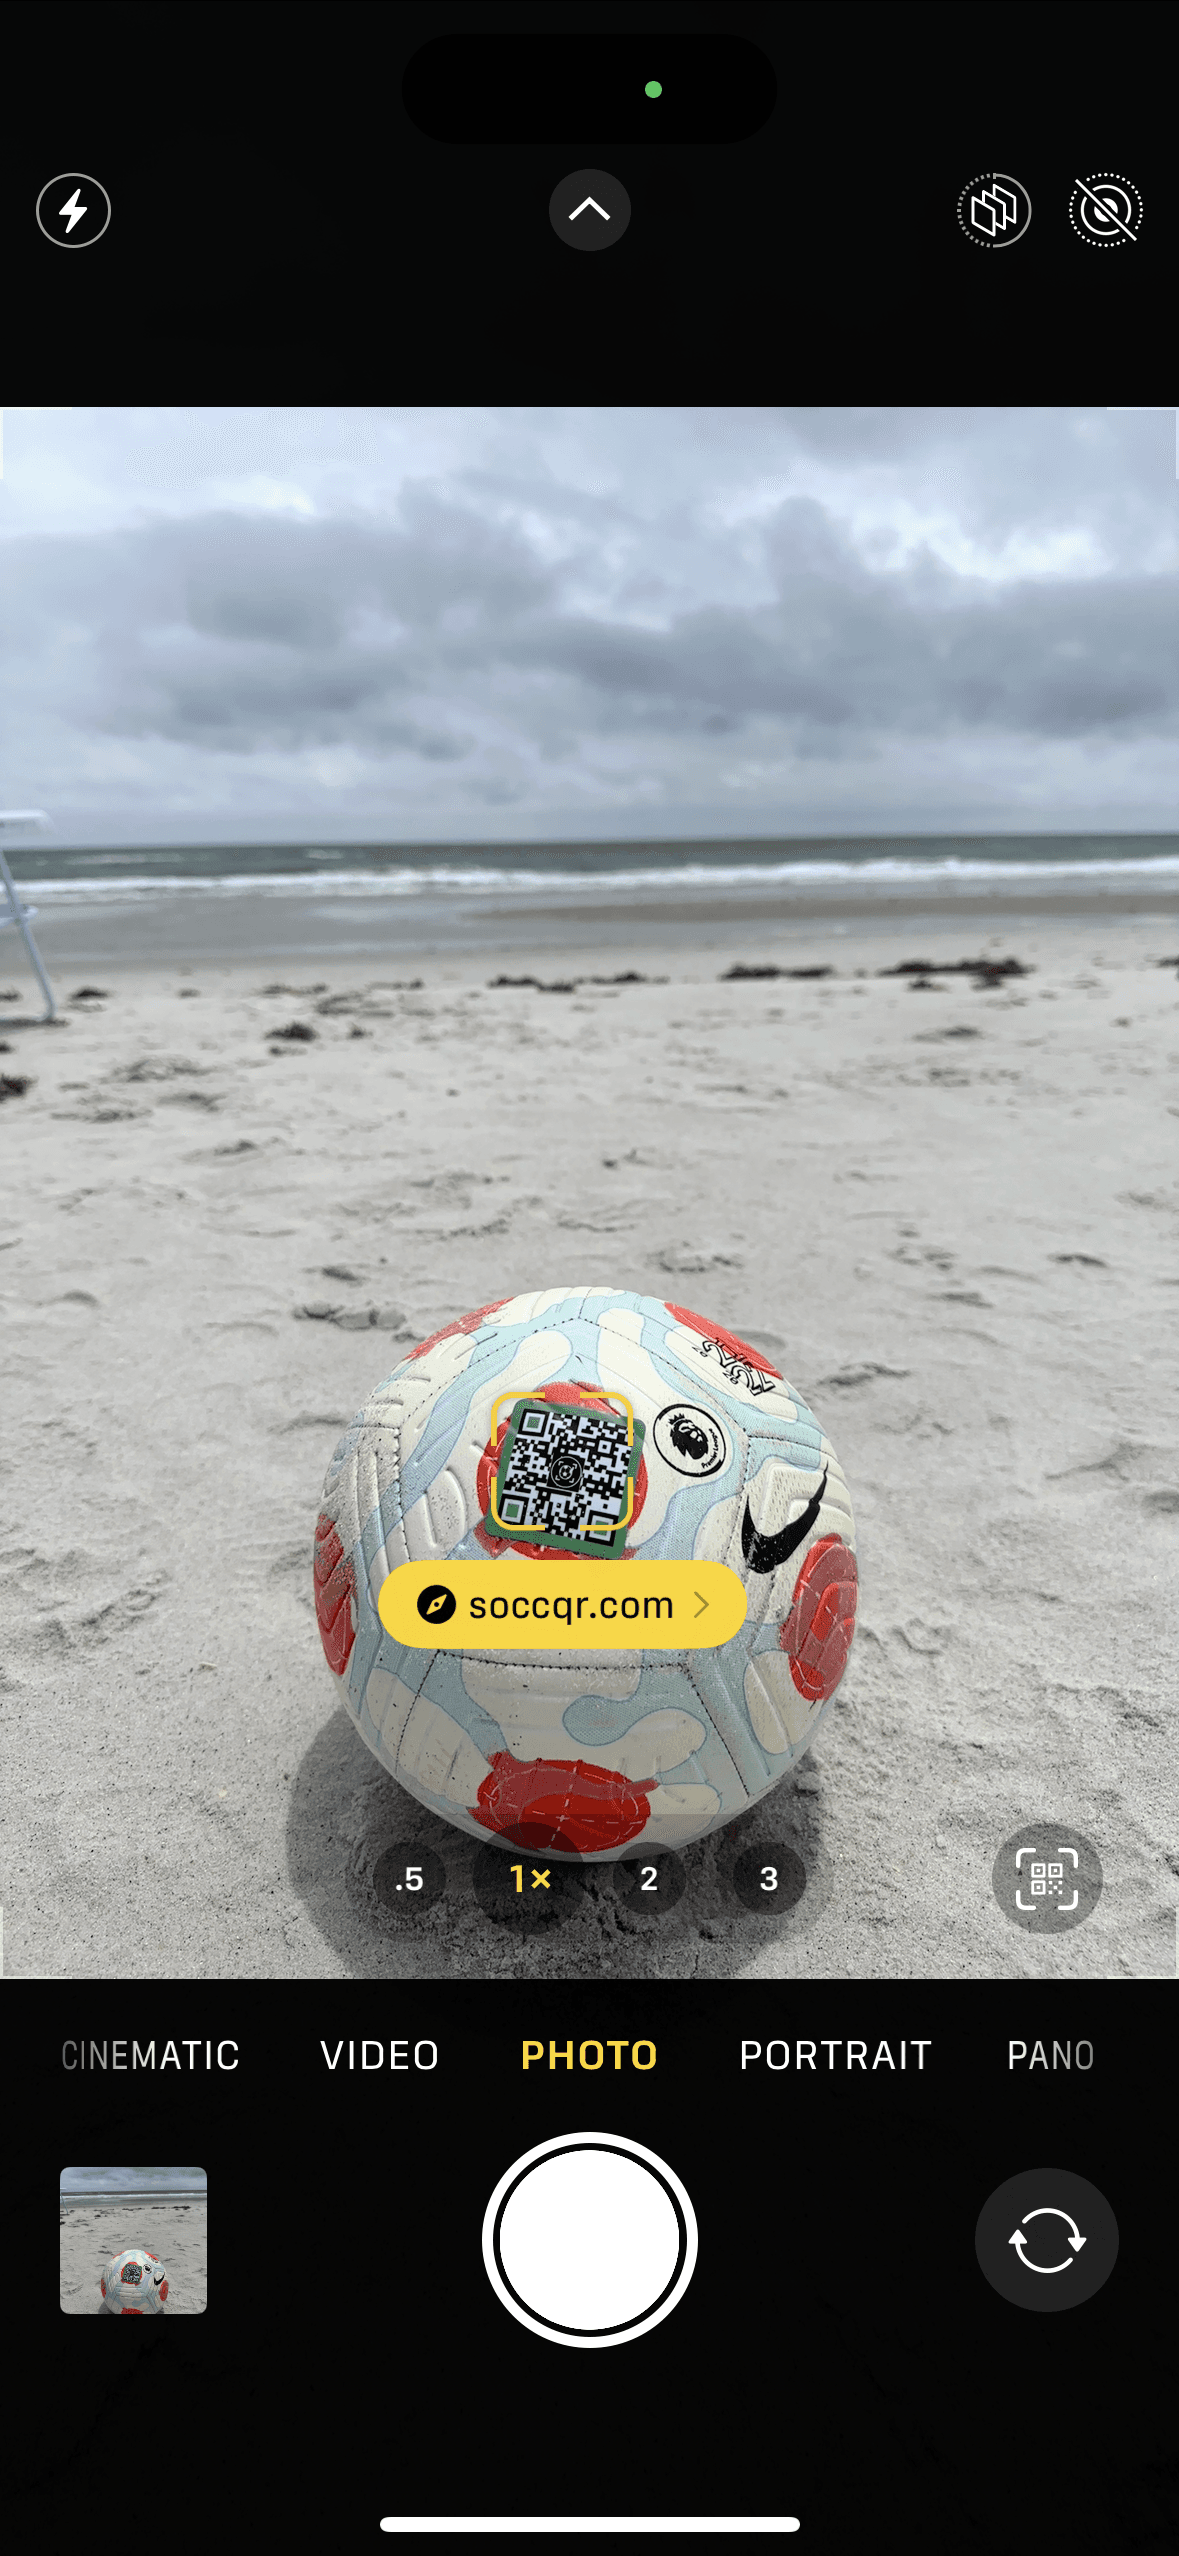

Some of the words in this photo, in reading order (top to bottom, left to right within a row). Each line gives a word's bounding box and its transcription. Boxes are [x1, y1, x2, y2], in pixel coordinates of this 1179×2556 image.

[708, 1428, 719, 1452] League
[700, 1451, 718, 1469] Premier
[469, 1596, 674, 1626] soccqr.com
[395, 1866, 424, 1893] .5
[641, 1866, 659, 1892] 2
[760, 1866, 779, 1892] 3
[61, 2039, 240, 2071] CINEMATIC
[319, 2039, 439, 2071] VIDEO
[521, 2039, 658, 2071] PHOTO
[740, 2039, 933, 2071] PORTRAIT
[1007, 2039, 1095, 2071] PANO
